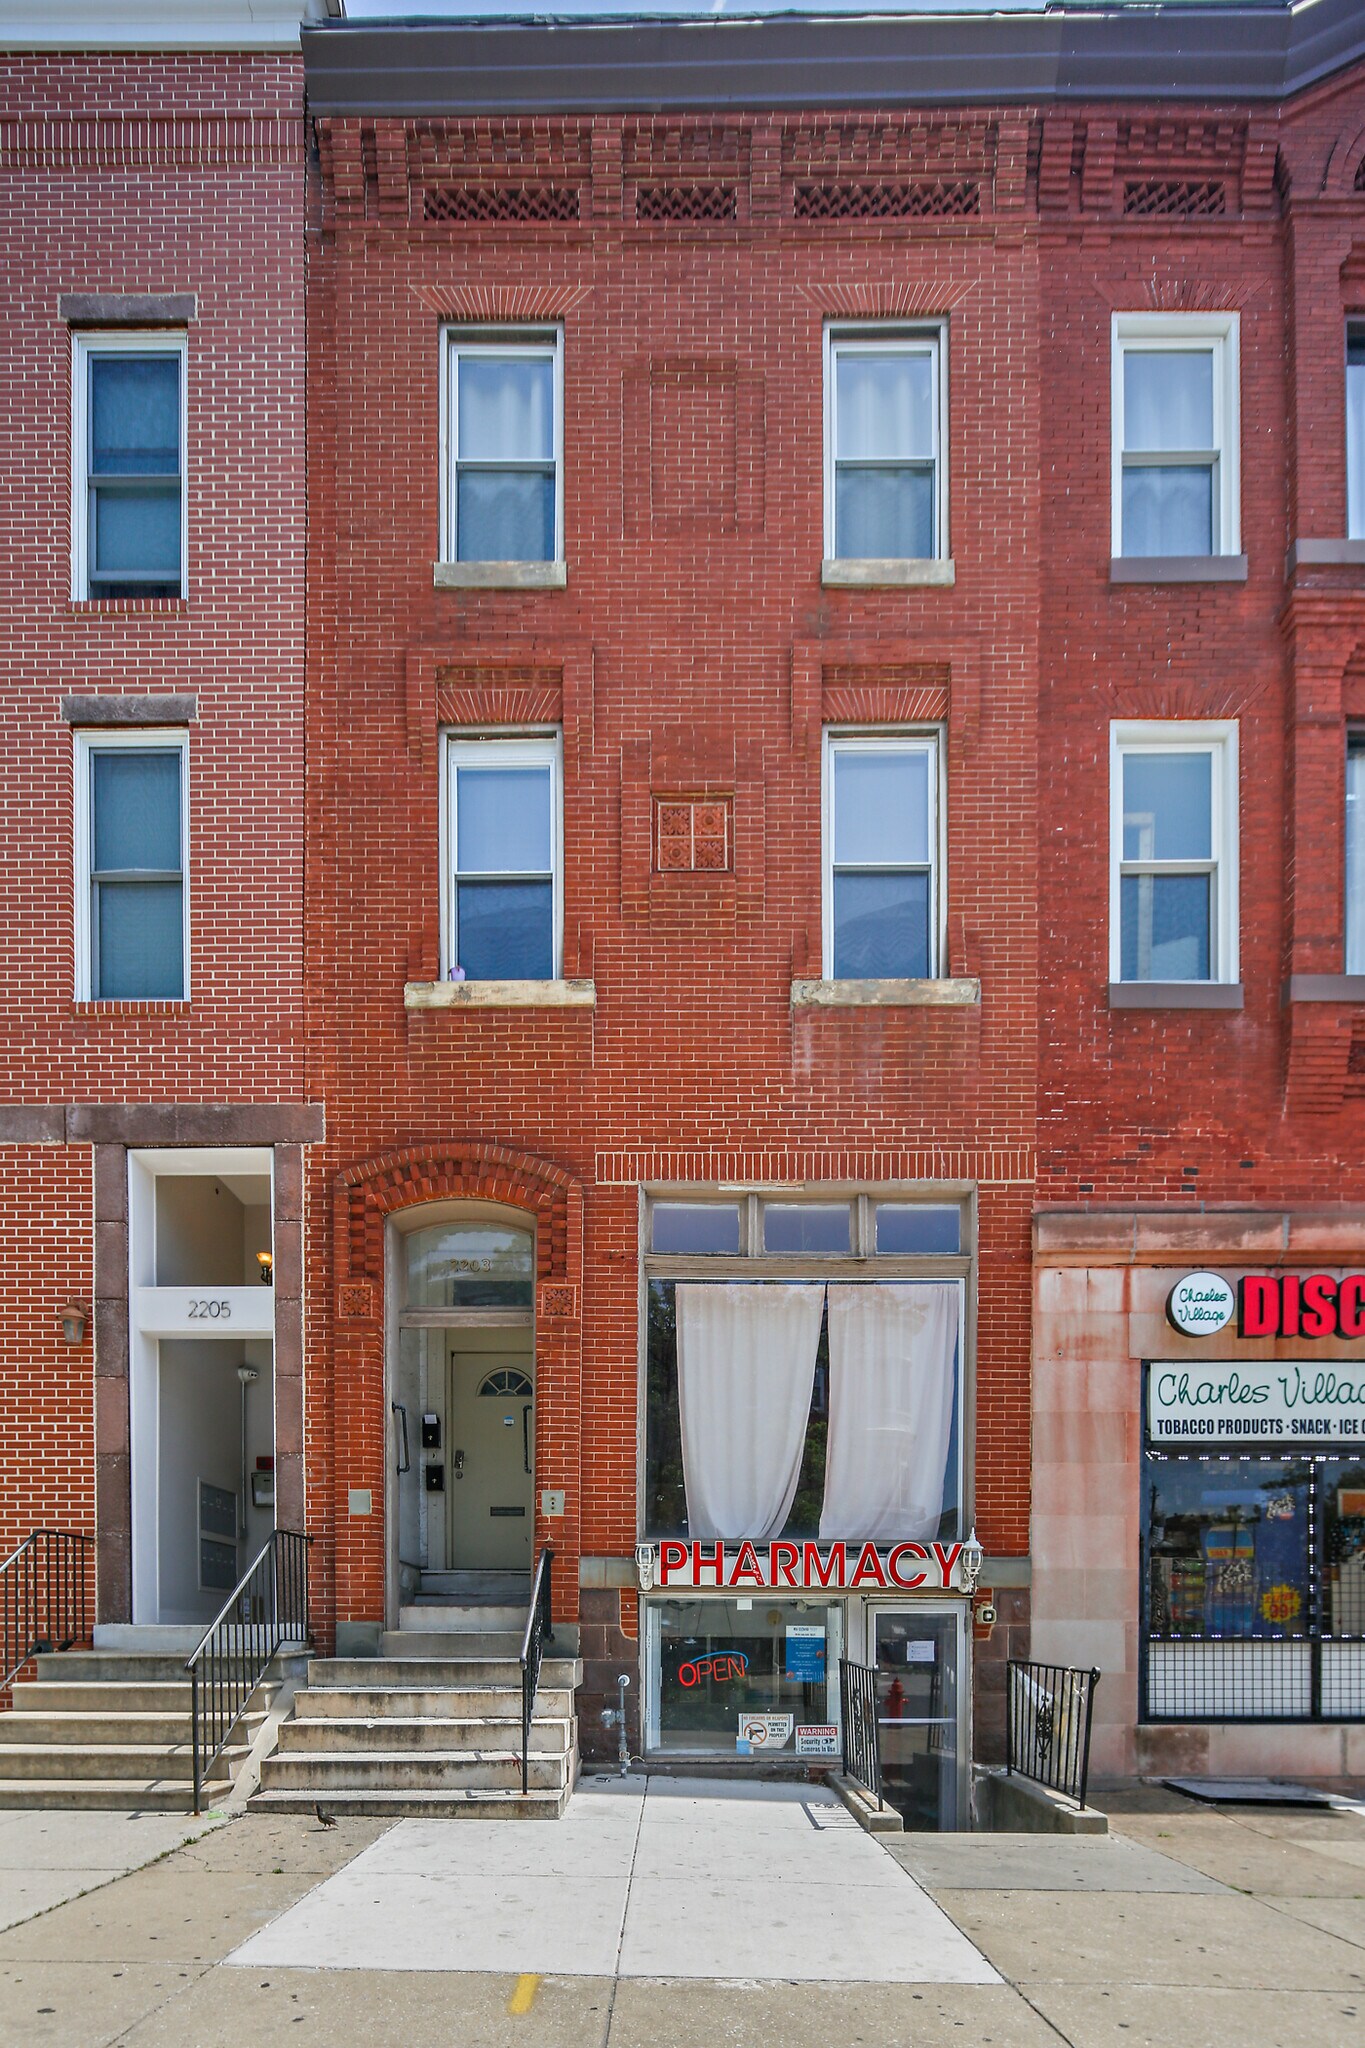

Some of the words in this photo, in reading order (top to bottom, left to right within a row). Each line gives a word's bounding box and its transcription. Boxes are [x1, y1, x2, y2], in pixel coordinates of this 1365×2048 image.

[450, 1258, 491, 1273] 2203
[187, 1300, 232, 1319] 2205
[1177, 1304, 1226, 1326] Village
[1241, 1273, 1365, 1337] DISC
[1157, 1373, 1270, 1406] Charles
[1157, 1419, 1214, 1435] TOBACCO
[1218, 1419, 1283, 1435] PRODUCTS
[1339, 1419, 1358, 1435] ICE
[659, 1539, 965, 1590] PHARMACY
[678, 1656, 745, 1687] OPEN
